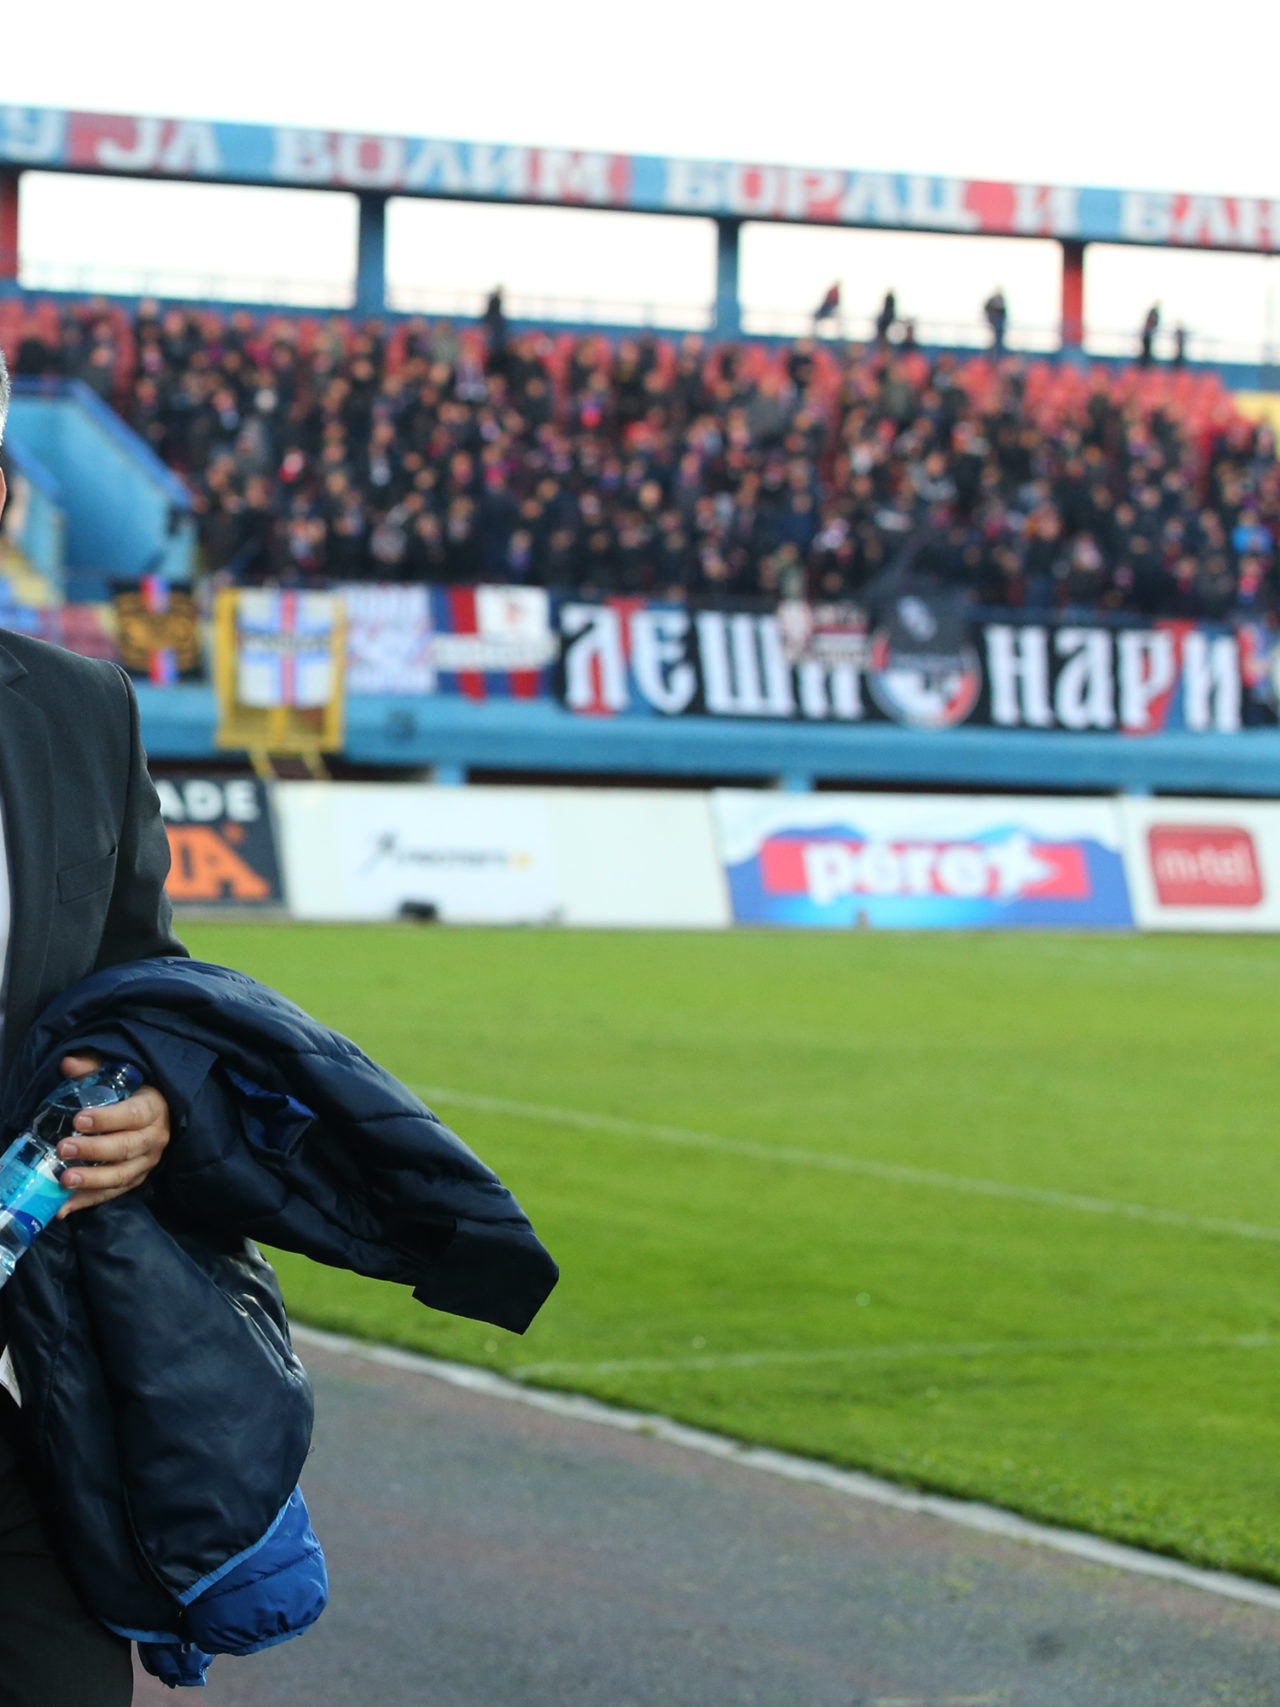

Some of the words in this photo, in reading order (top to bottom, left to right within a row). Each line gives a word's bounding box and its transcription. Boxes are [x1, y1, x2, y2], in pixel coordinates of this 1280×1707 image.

[273, 126, 611, 203] ВОЛИМ
[664, 160, 982, 230] БОРАЦ
[1012, 185, 1081, 235] И
